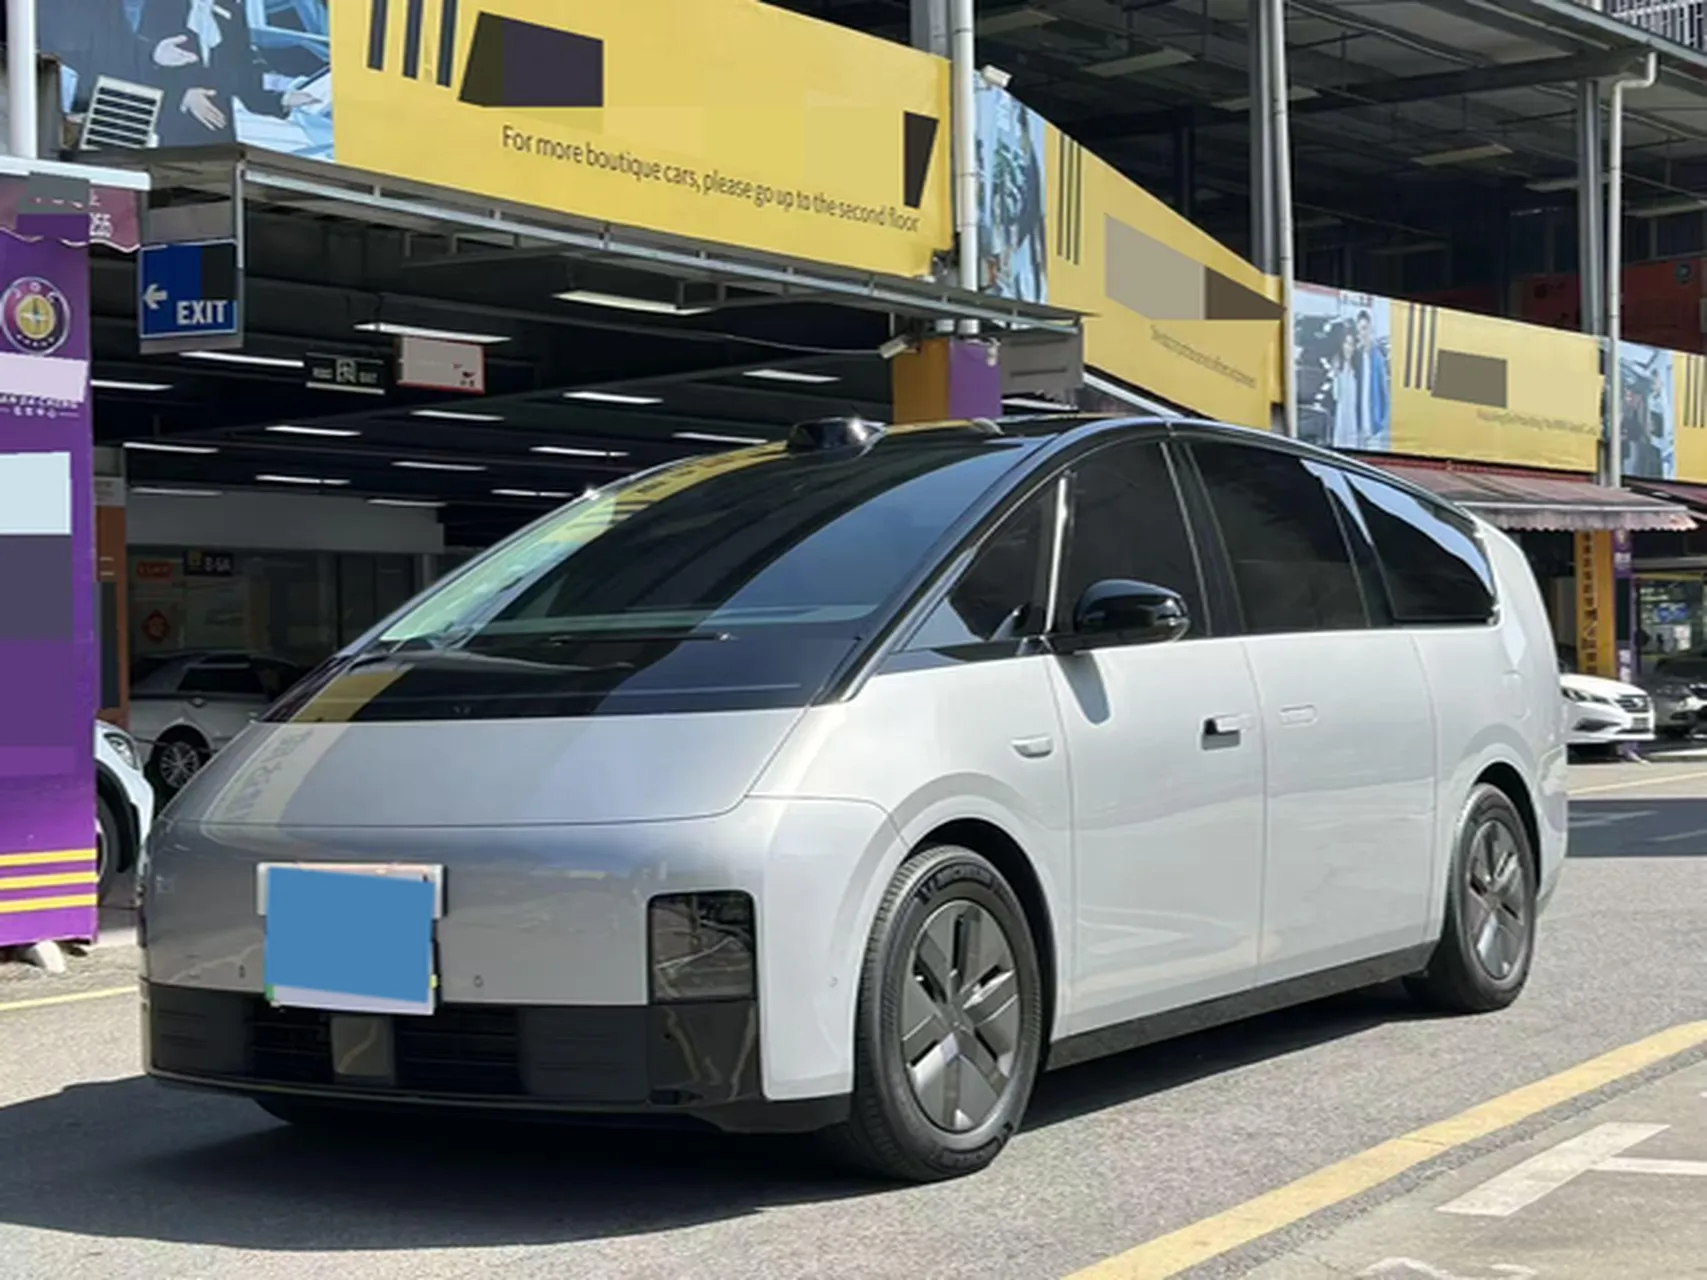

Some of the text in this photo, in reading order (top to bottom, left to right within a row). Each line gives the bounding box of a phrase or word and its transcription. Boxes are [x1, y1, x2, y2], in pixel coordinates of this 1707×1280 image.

[502, 124, 532, 152] For
[536, 137, 583, 163] more
[586, 142, 661, 182] boutique
[663, 163, 700, 192] cars,
[702, 169, 752, 199] please
[754, 184, 773, 207] go
[776, 189, 794, 212] up
[796, 190, 811, 211] to
[813, 192, 836, 216] the
[838, 201, 886, 226] second
[176, 300, 228, 325] EXIT
